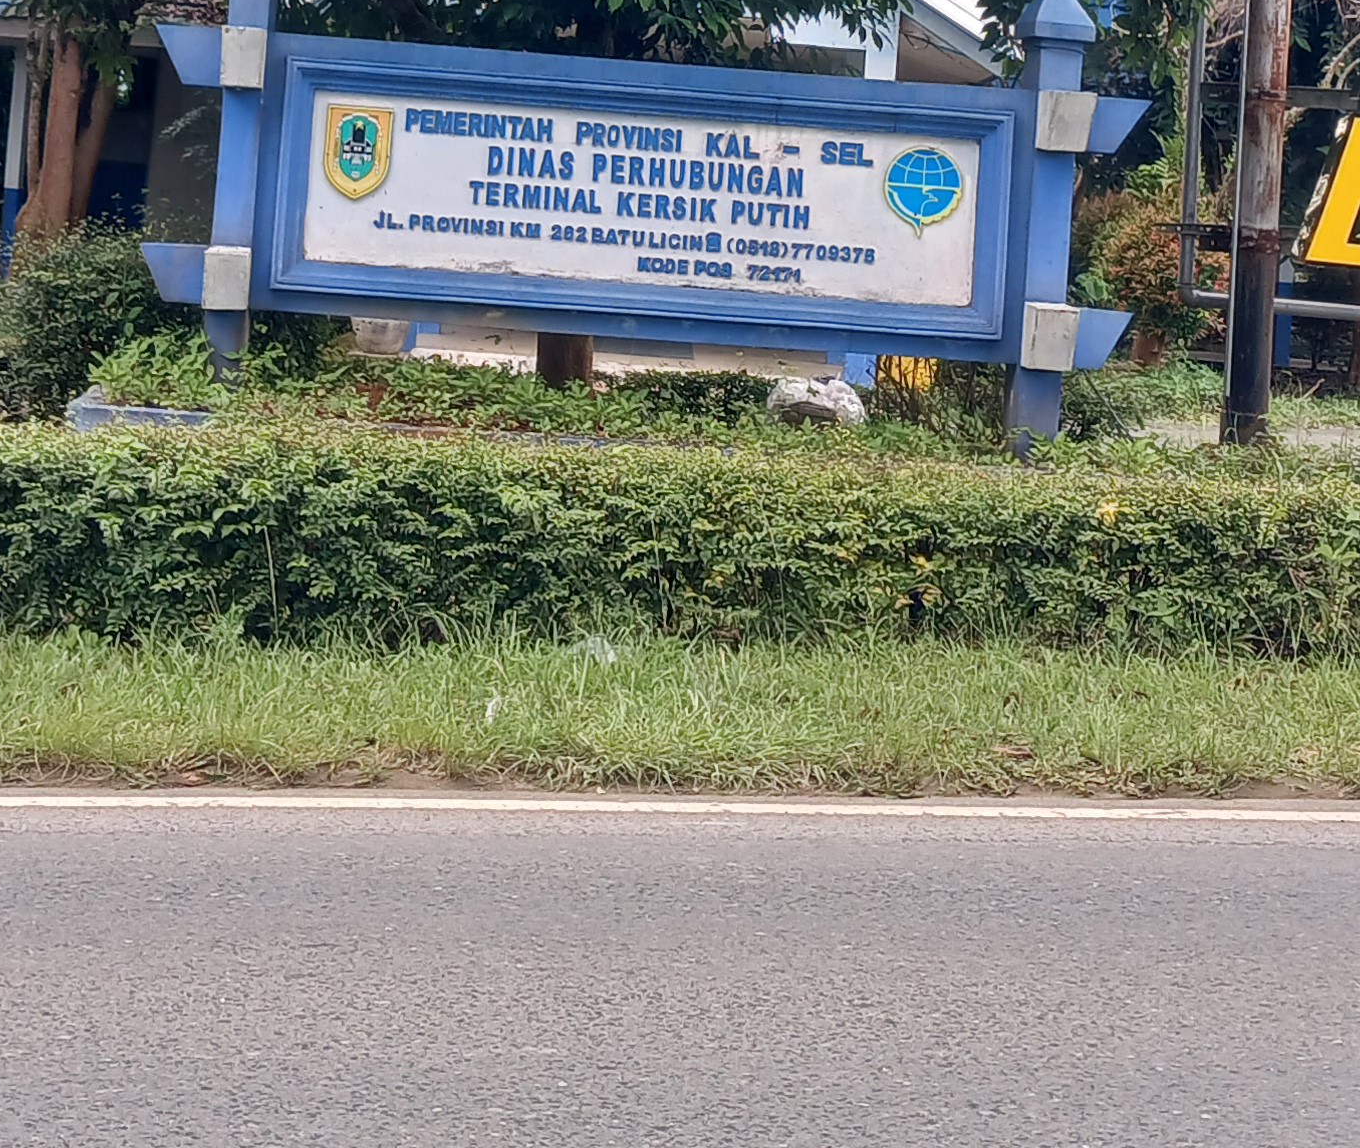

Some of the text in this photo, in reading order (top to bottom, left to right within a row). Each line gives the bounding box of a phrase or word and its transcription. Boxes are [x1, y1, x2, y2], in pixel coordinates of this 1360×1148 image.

[405, 108, 554, 142] PEMERINTAH
[576, 121, 683, 153] PROVINSI
[706, 133, 760, 160] KAL
[821, 141, 874, 167] SEL
[487, 146, 804, 198] DINAS PERHUBUNGAN
[469, 180, 810, 230] TERMINAL KERSIK PUTIH
[373, 210, 403, 230] JL.
[408, 214, 504, 237] PROVINSI
[510, 222, 541, 239] KM
[591, 228, 704, 252] BATULICIN
[637, 257, 689, 275] KODE
[693, 261, 733, 279] POS
